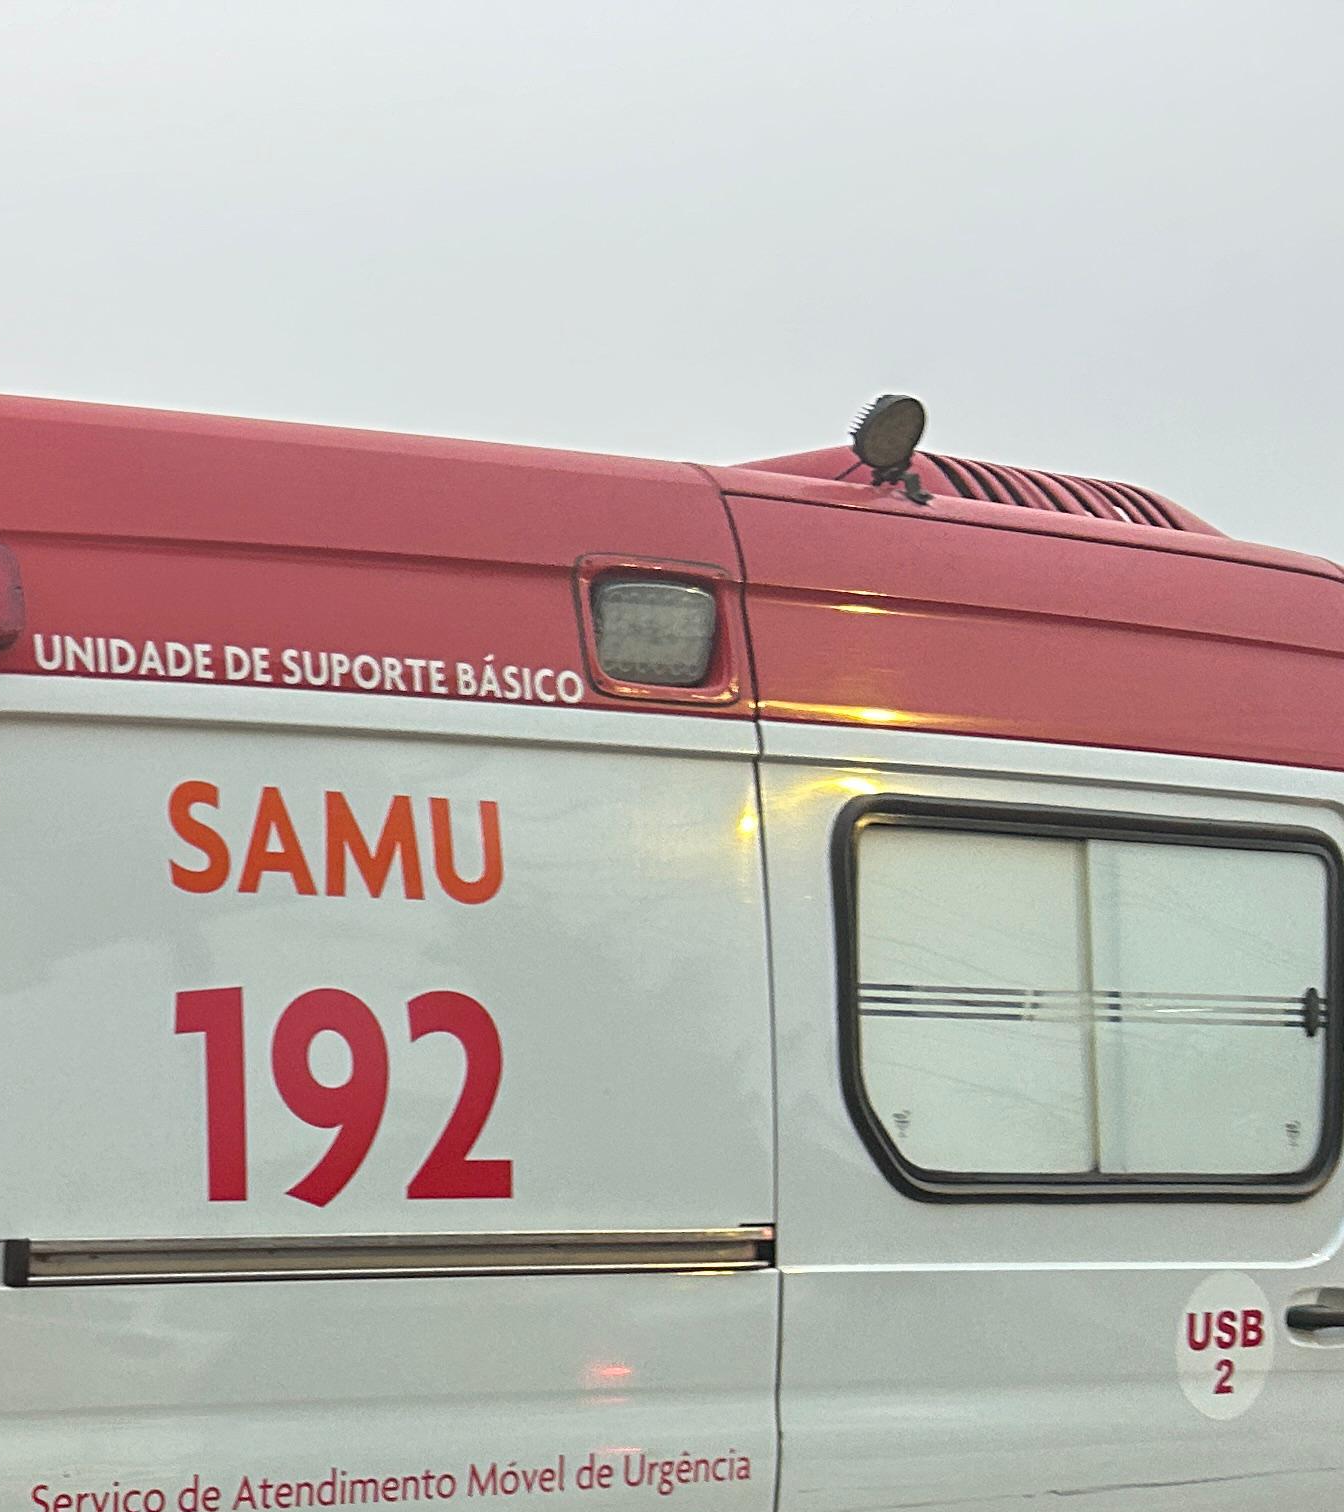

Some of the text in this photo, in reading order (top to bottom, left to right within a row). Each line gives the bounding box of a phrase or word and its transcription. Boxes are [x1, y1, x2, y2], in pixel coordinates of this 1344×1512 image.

[33, 633, 585, 704] UNIDADE DE SUPORTE BÁSICO
[167, 780, 505, 905] SAMU
[174, 986, 514, 1208] 192
[1185, 1308, 1265, 1350] USB
[1214, 1359, 1235, 1394] 2
[231, 1467, 457, 1511] Atendimento
[466, 1454, 565, 1498] Móvel
[575, 1453, 614, 1492] de
[623, 1448, 751, 1496] Urgência
